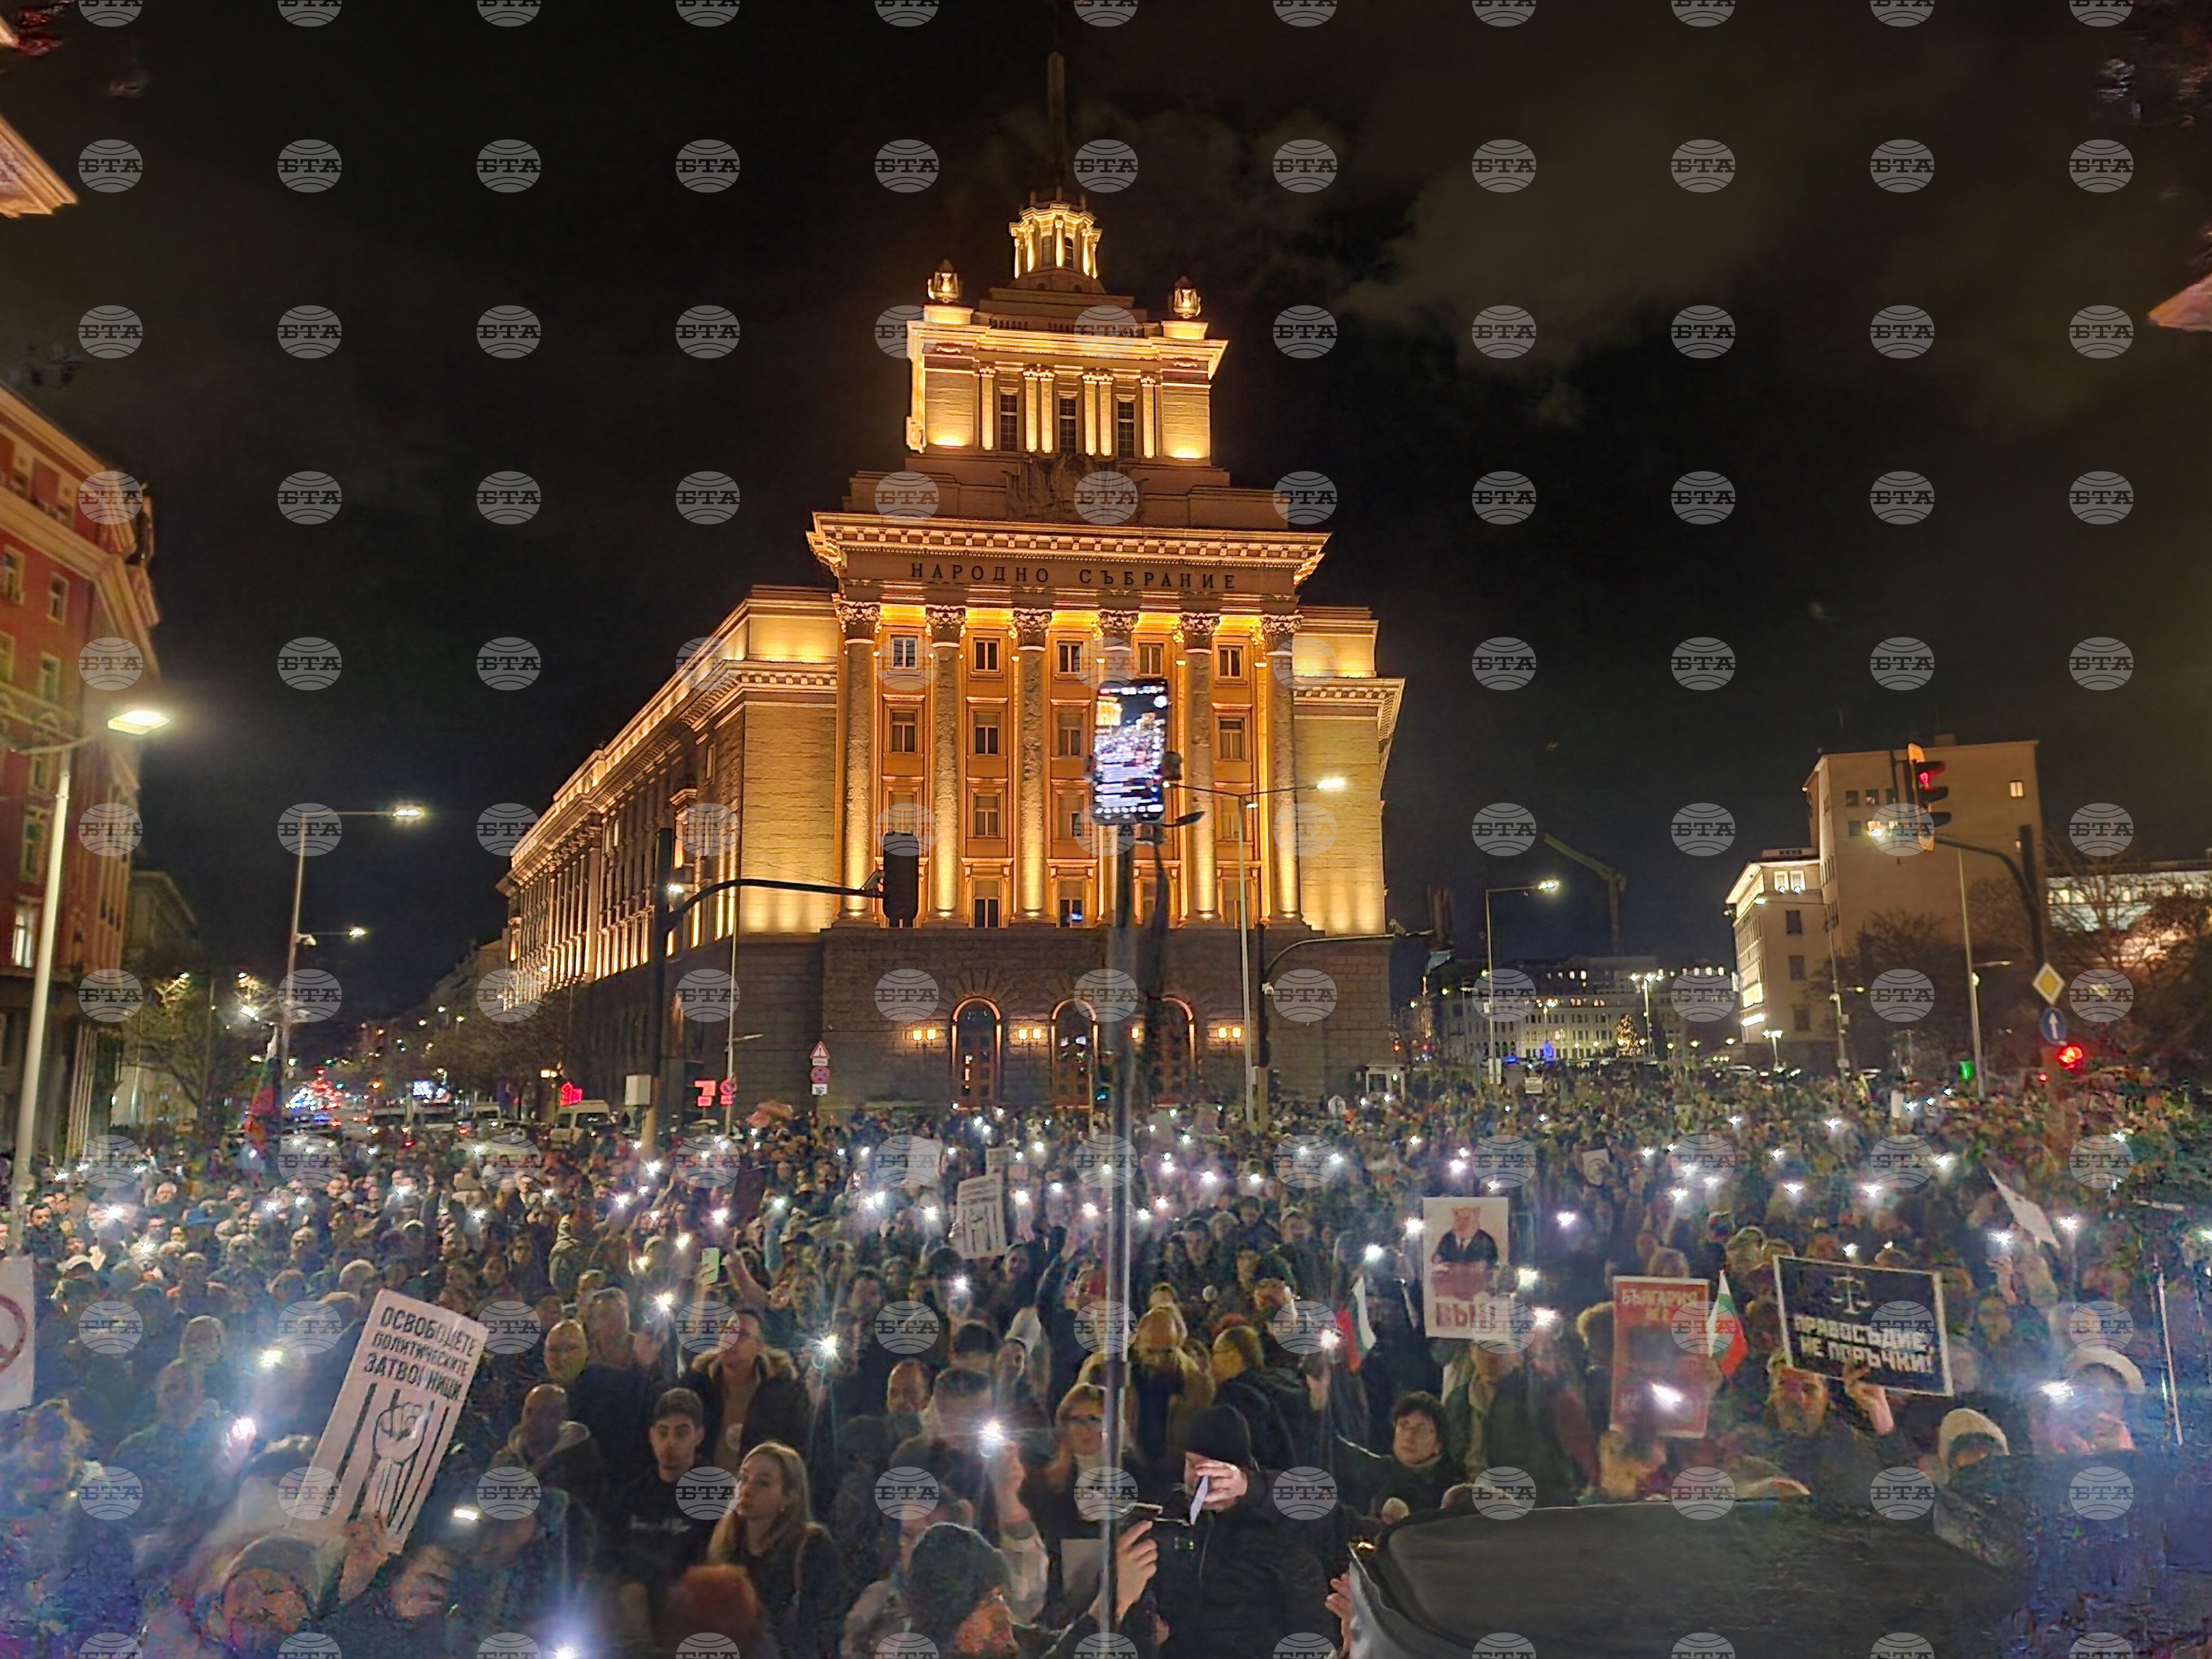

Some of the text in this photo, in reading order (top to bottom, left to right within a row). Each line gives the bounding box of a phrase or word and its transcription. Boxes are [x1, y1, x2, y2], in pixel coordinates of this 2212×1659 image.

[911, 563, 1235, 588] НАРОДНО СЪБРАНИЕ
[380, 1306, 476, 1357] ОСВОБОДЕТЕ
